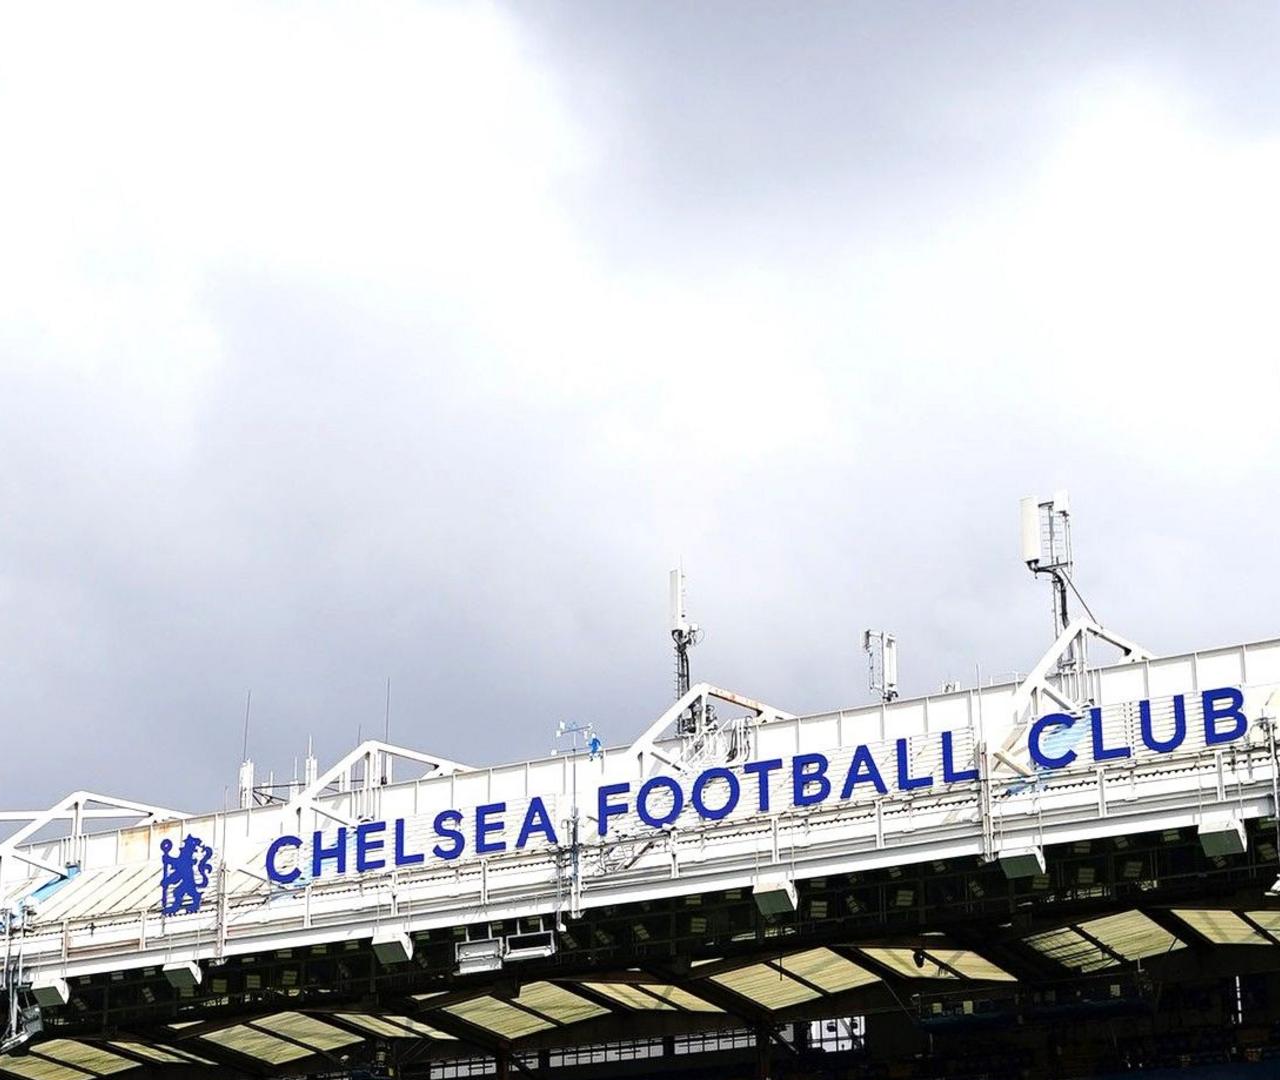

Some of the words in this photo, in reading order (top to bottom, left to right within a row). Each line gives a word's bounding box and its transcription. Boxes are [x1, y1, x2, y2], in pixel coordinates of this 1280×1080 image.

[267, 799, 557, 885] CHELSEA
[597, 730, 978, 835] FOOTBALL
[1027, 687, 1247, 771] CLUB
